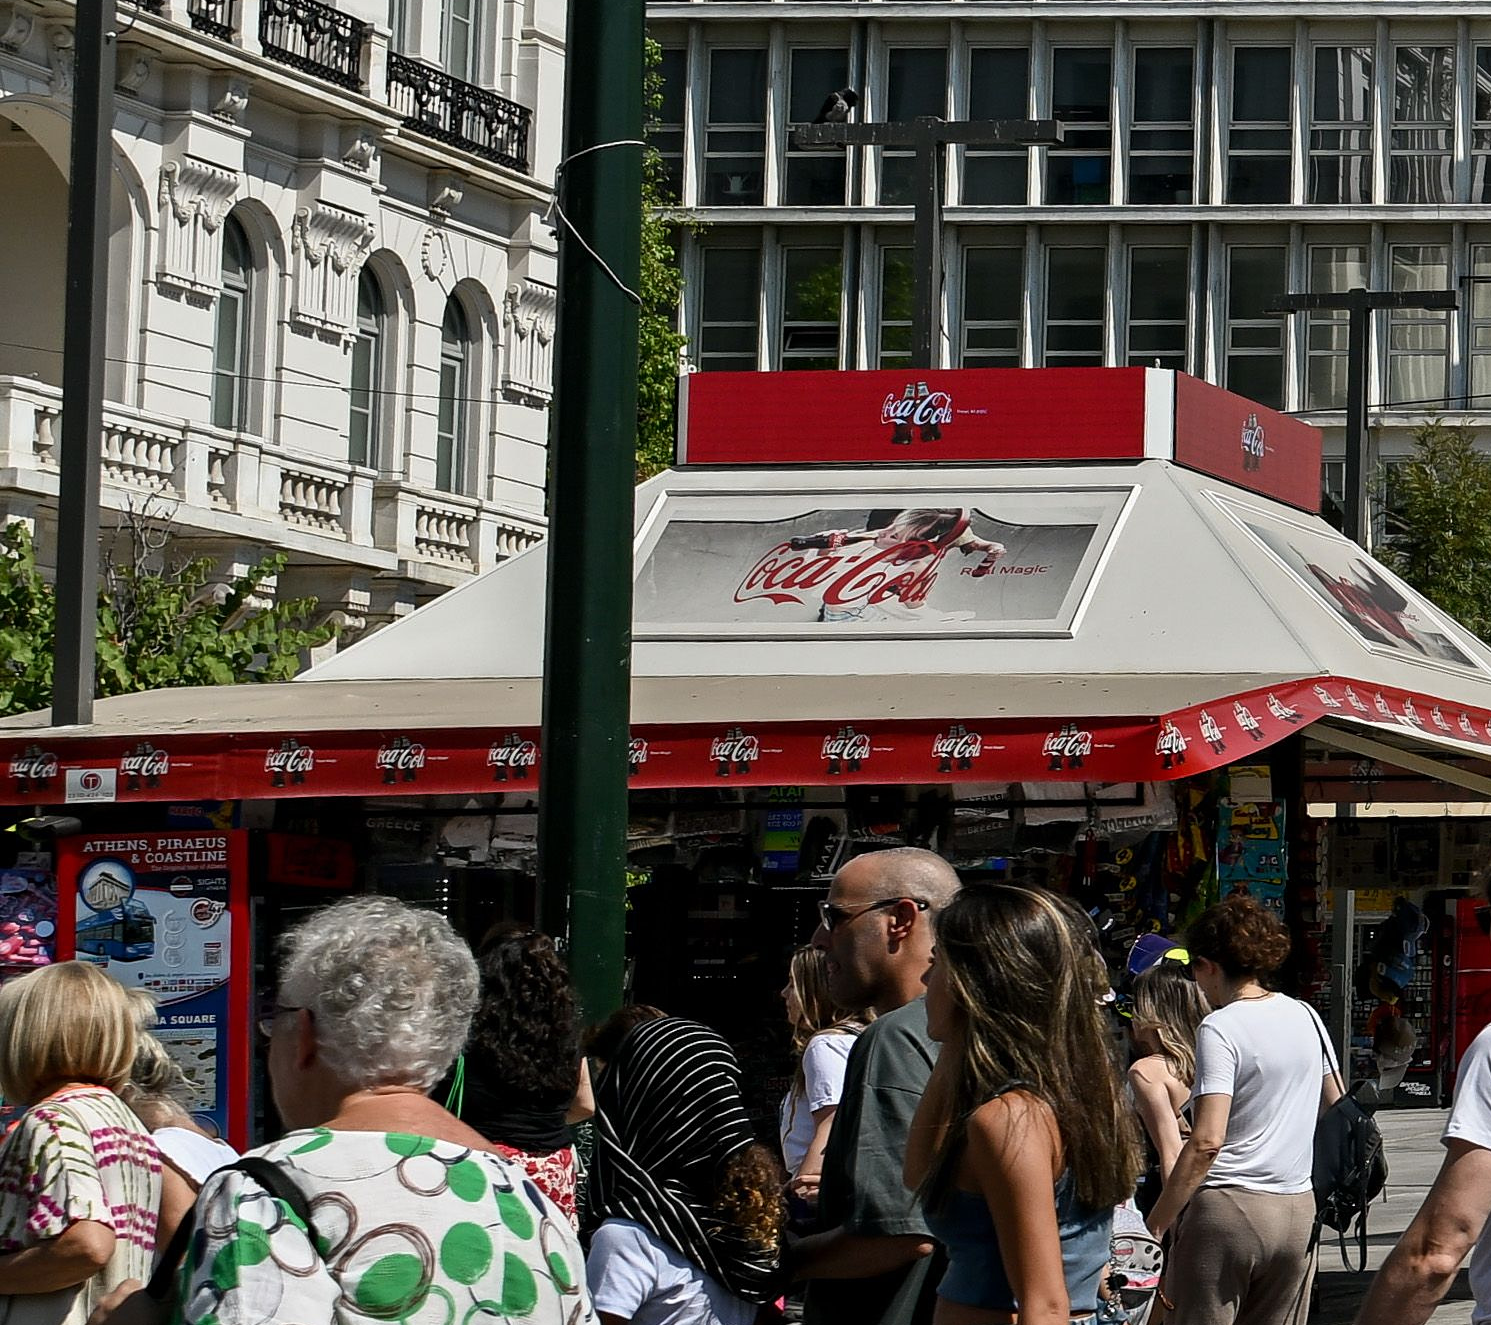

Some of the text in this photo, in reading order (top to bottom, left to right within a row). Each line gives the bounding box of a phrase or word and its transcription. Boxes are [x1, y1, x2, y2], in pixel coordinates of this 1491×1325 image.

[959, 564, 1049, 576] Rl Magic
[366, 816, 423, 832] GREECE
[82, 837, 227, 853] ATHENS, PIRAEUS
[131, 850, 228, 864] & COASTLINE
[170, 1014, 217, 1025] SQUARE
